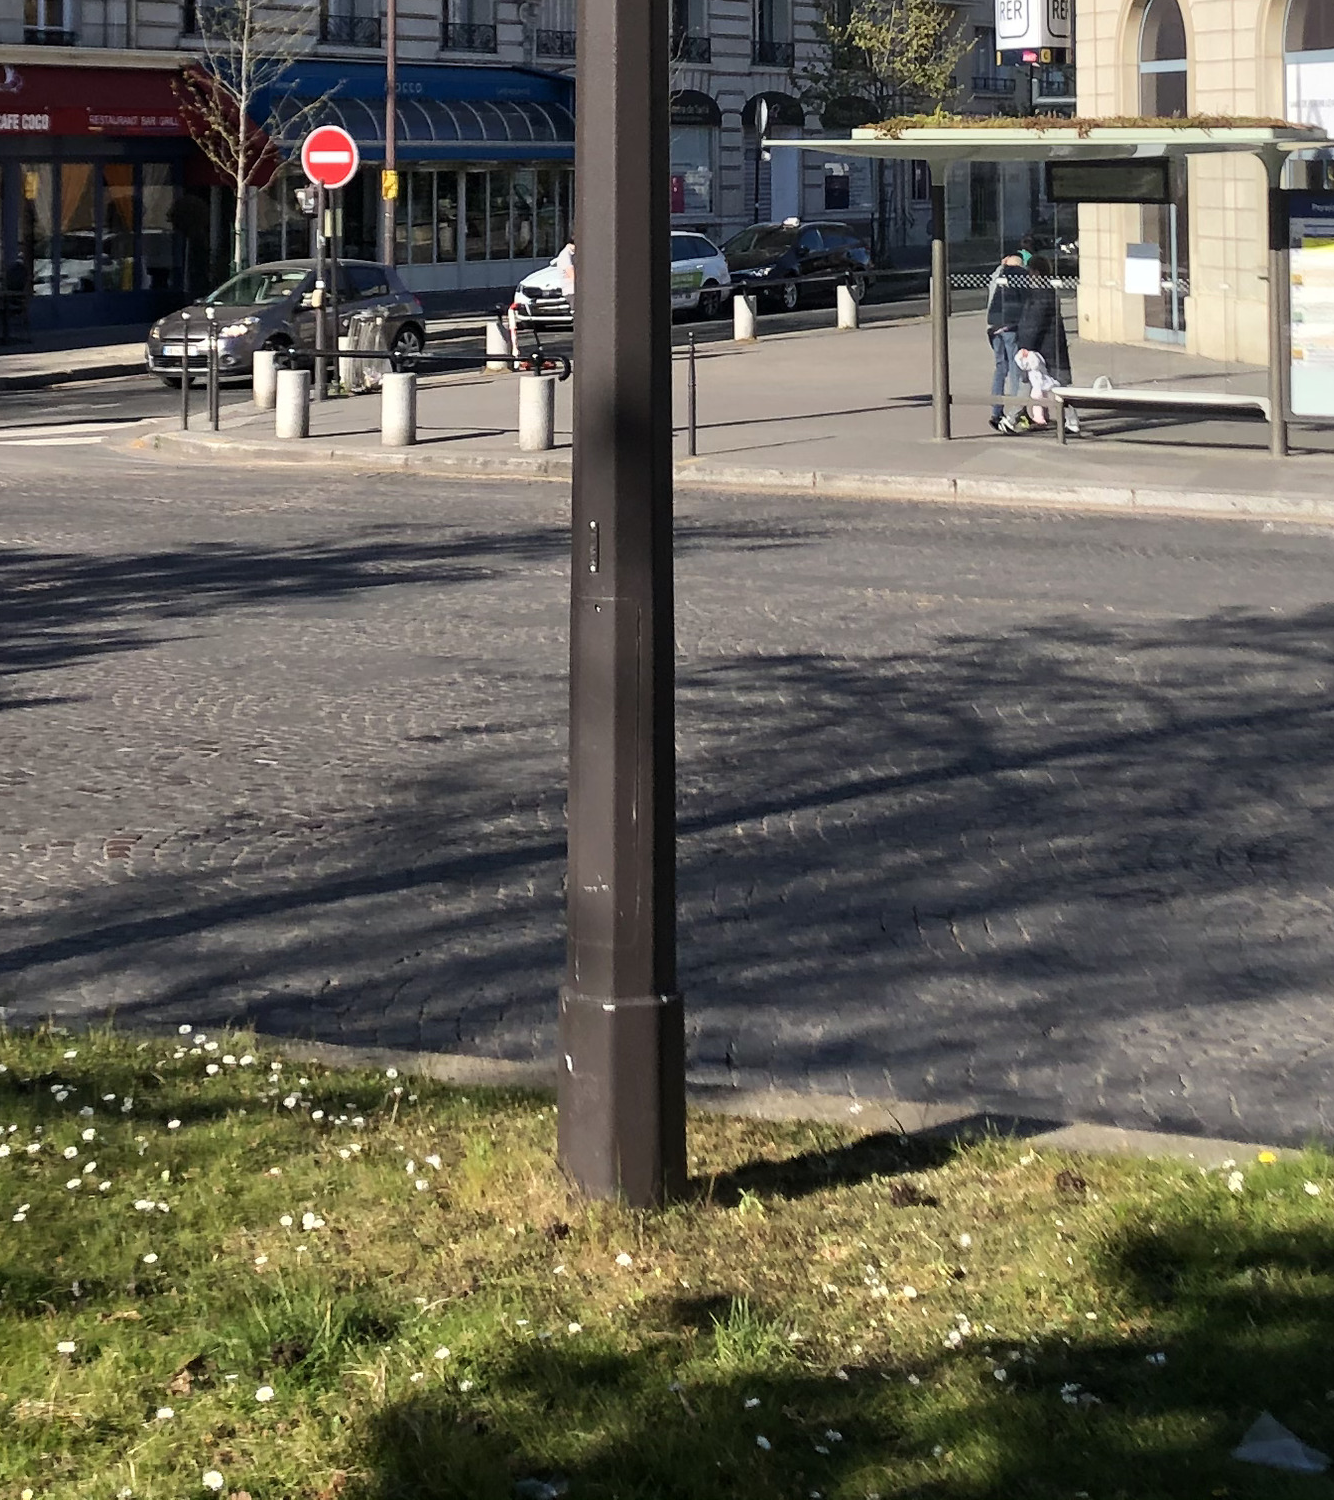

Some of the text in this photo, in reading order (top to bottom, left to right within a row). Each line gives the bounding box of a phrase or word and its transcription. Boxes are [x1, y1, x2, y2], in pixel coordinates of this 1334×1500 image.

[1000, 0, 1023, 20] RER
[22, 113, 49, 129] COCO
[89, 114, 139, 125] RESTAURANT
[141, 116, 156, 126] BAR
